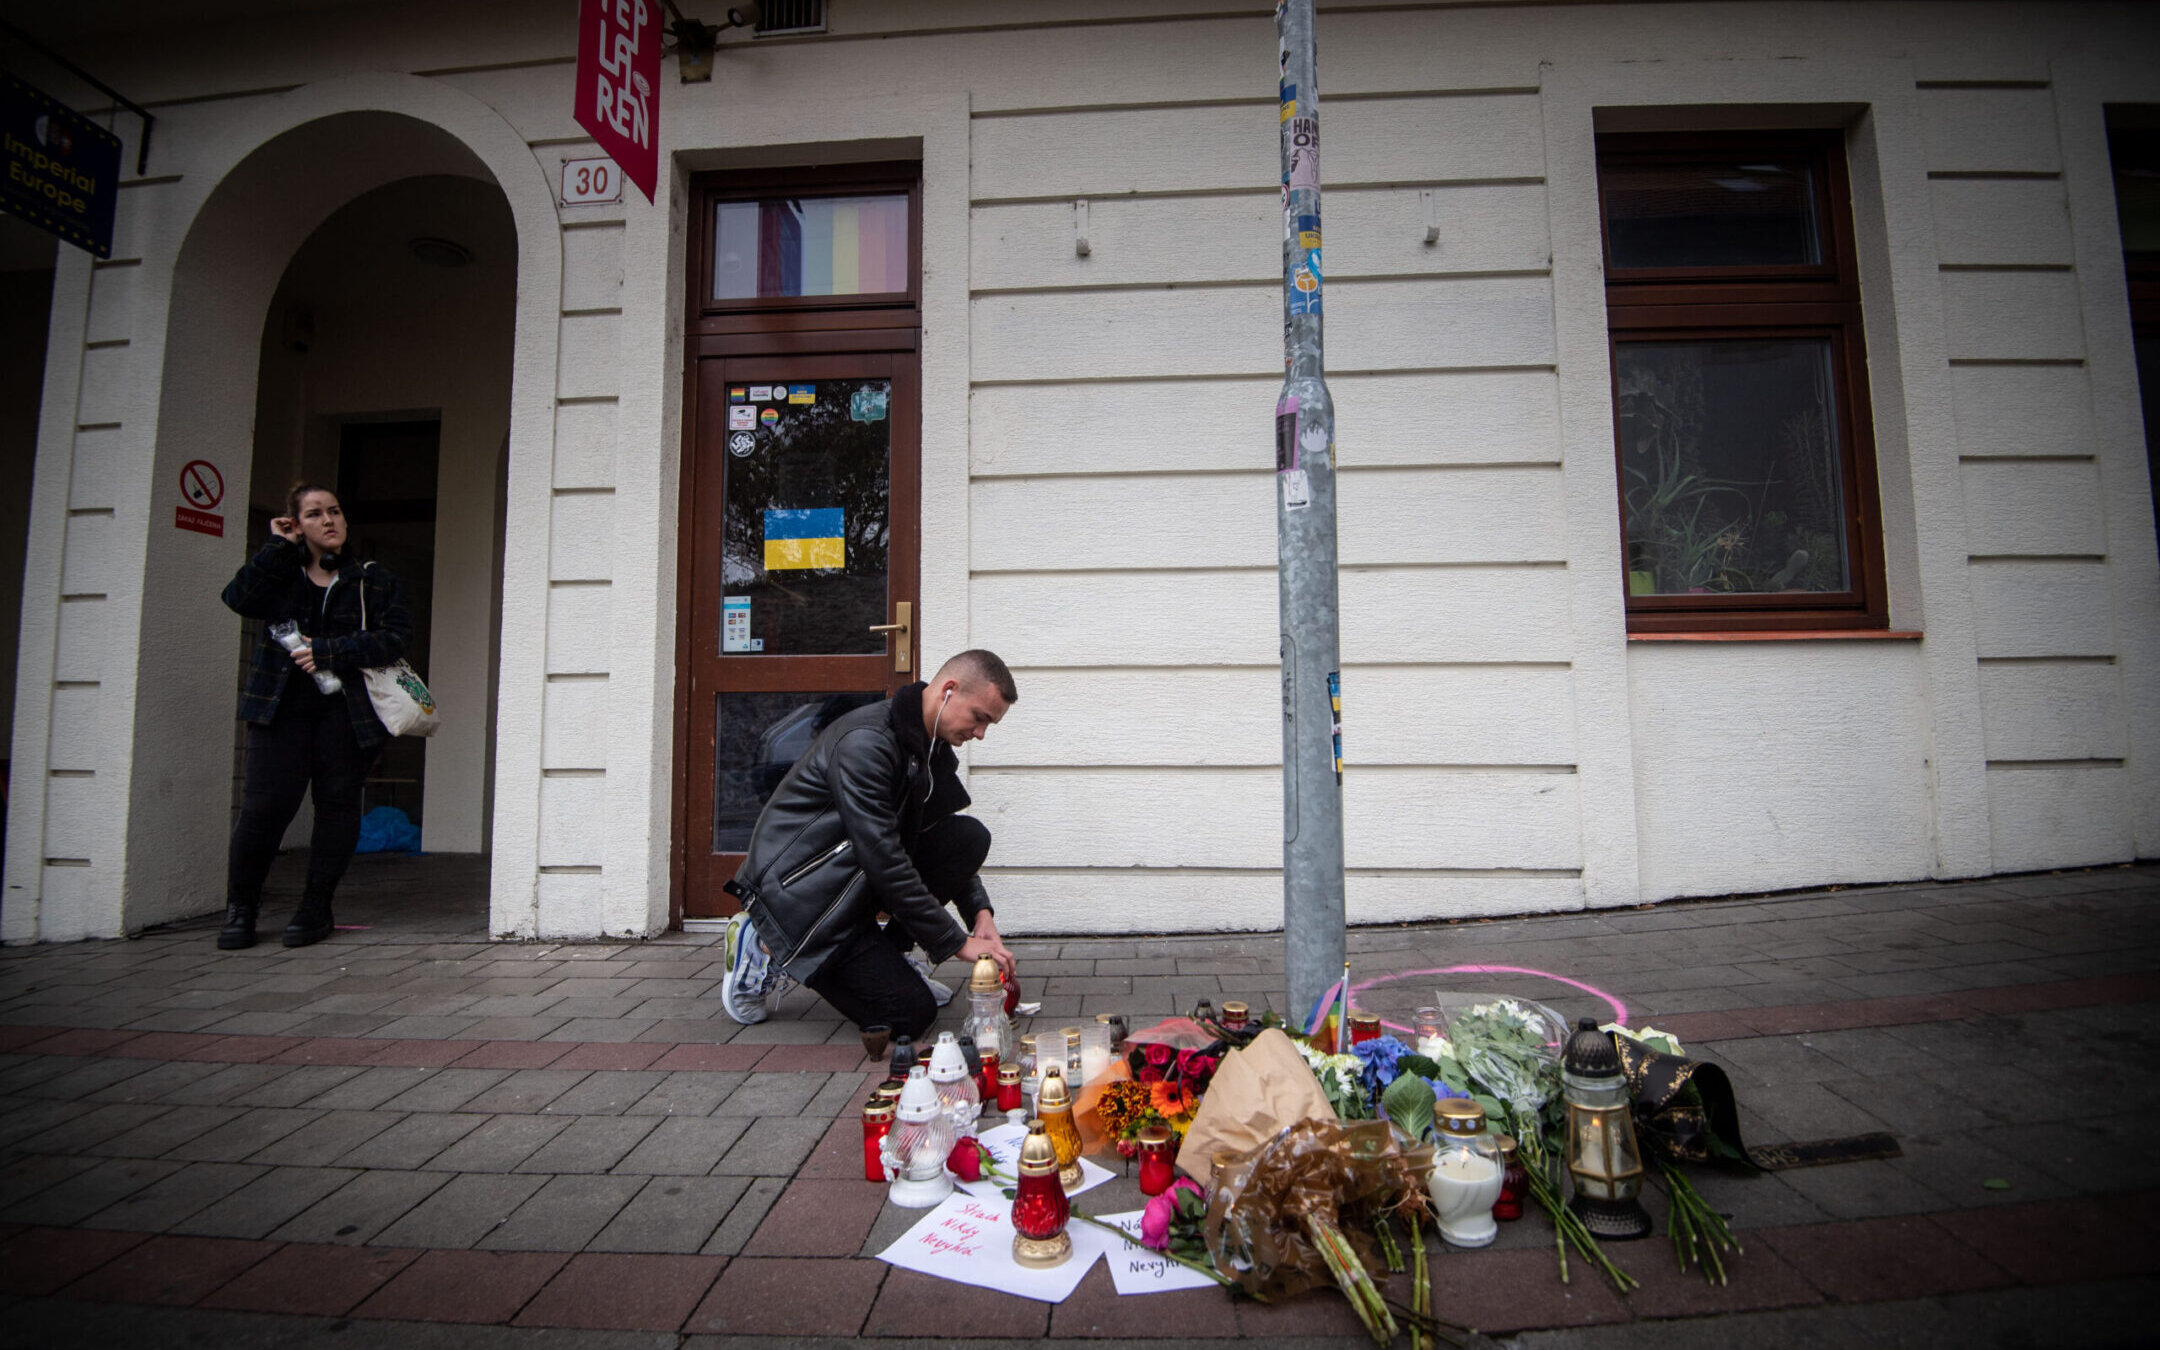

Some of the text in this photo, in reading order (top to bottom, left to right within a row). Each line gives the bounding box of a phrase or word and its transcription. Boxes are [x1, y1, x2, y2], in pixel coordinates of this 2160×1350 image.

[1293, 118, 1319, 134] HAN
[3, 130, 97, 196] Imperial
[8, 159, 87, 215] Europe
[576, 166, 608, 195] 30
[1120, 1218, 1141, 1231] Ná
